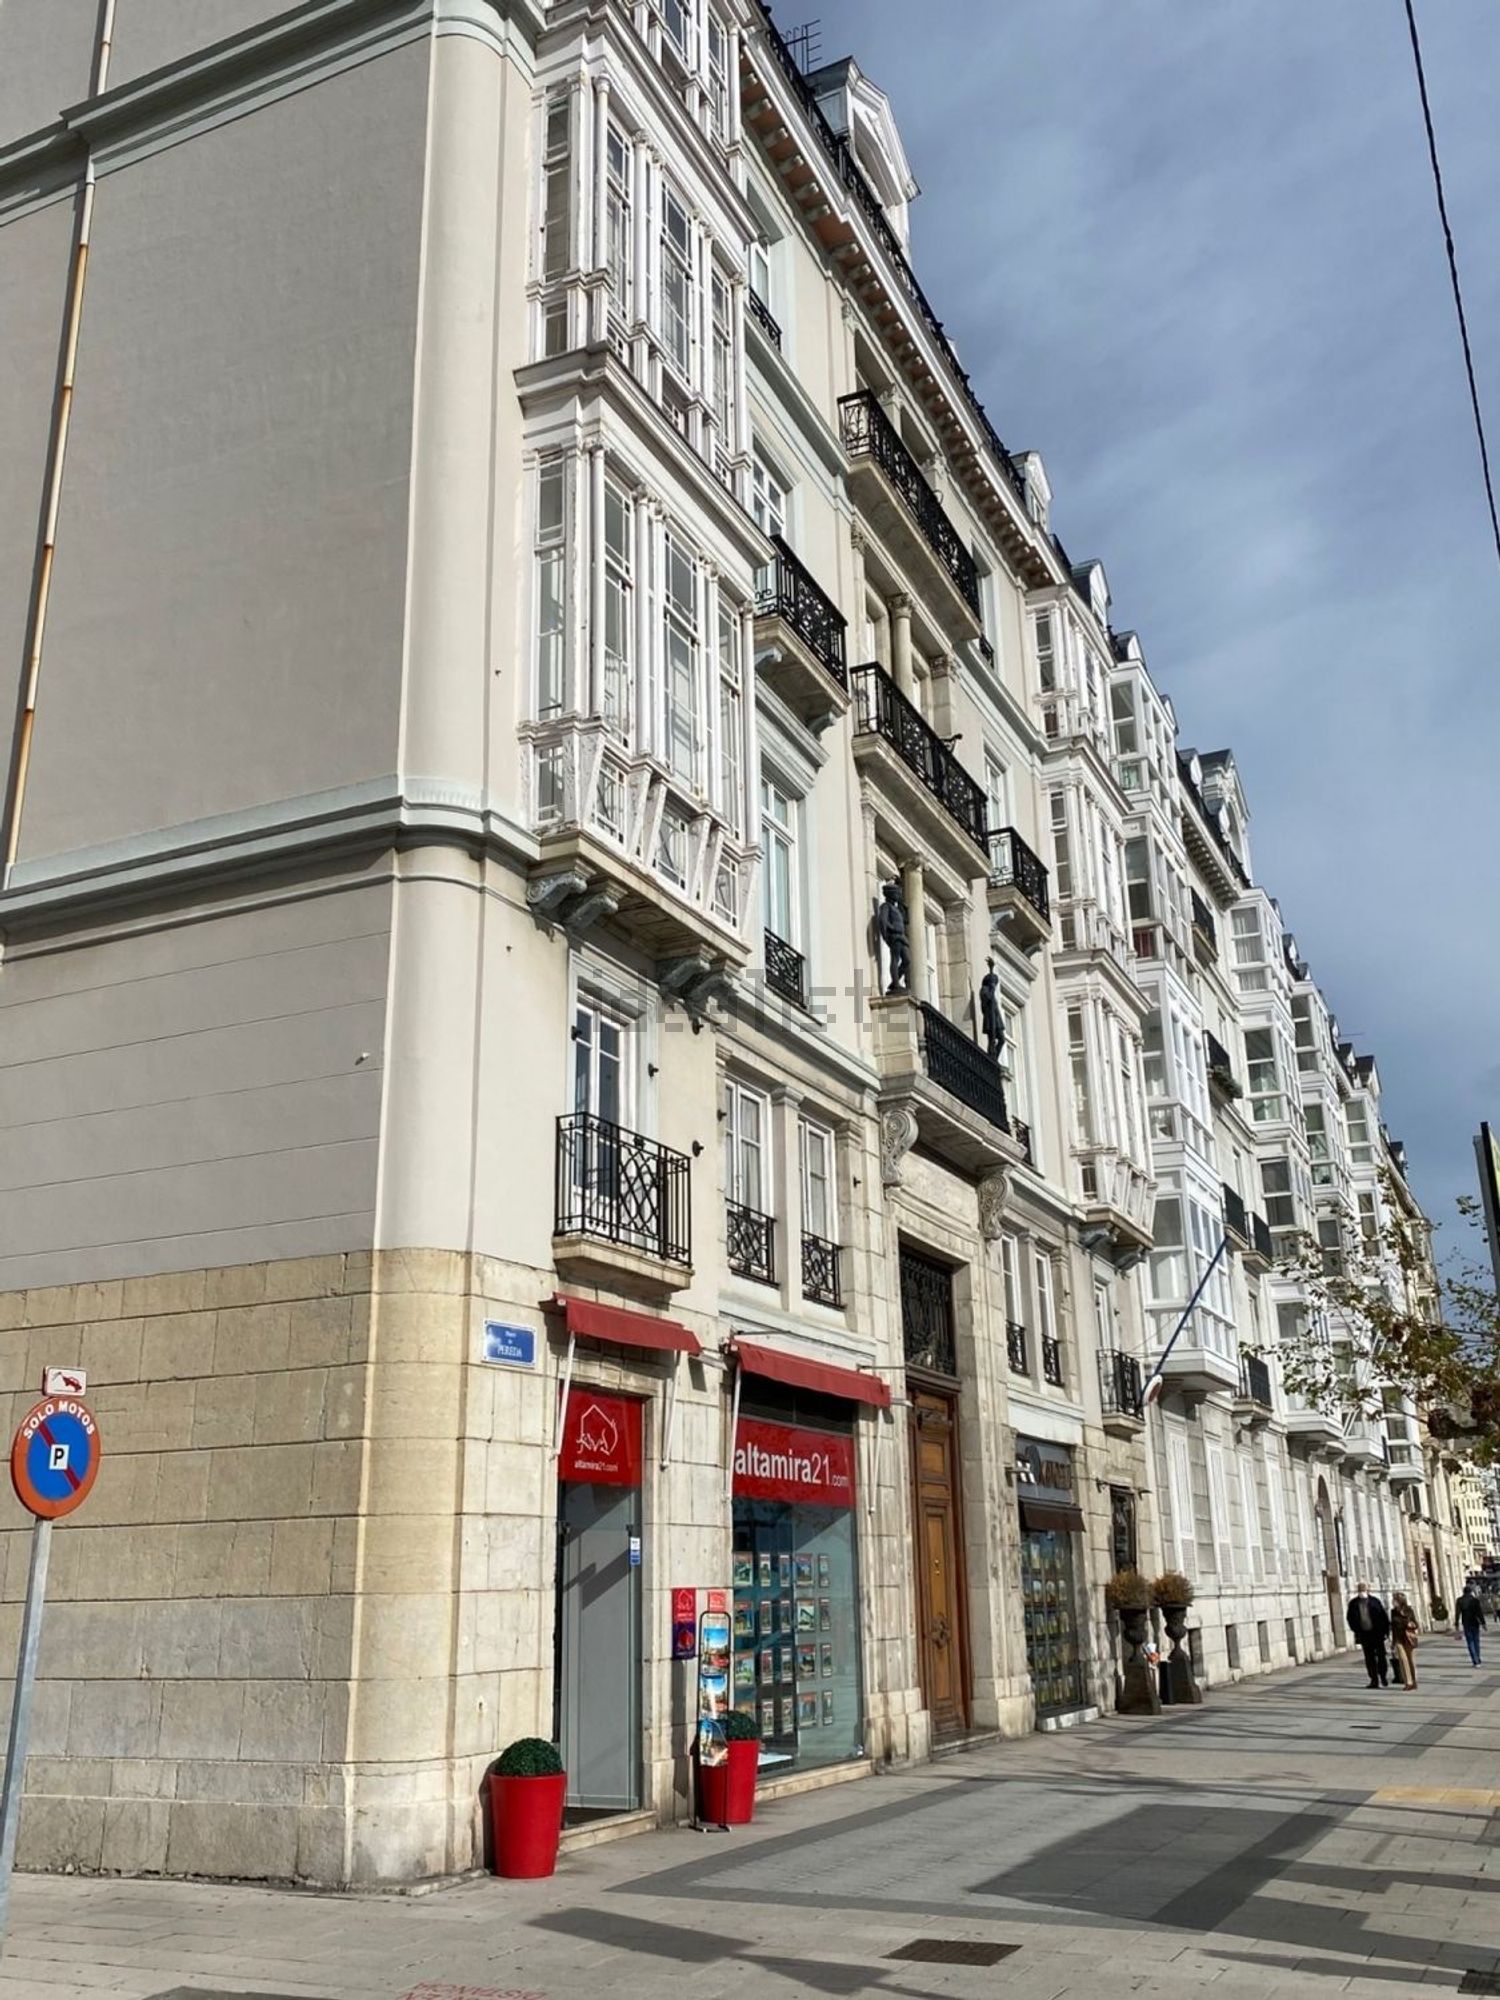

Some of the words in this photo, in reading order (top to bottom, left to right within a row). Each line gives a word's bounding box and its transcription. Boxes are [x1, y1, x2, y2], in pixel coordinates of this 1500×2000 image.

[24, 1405, 54, 1440] SOLO
[58, 1401, 95, 1435] MOTOS
[53, 1448, 64, 1466] P
[735, 1441, 848, 1487] altamira21.com
